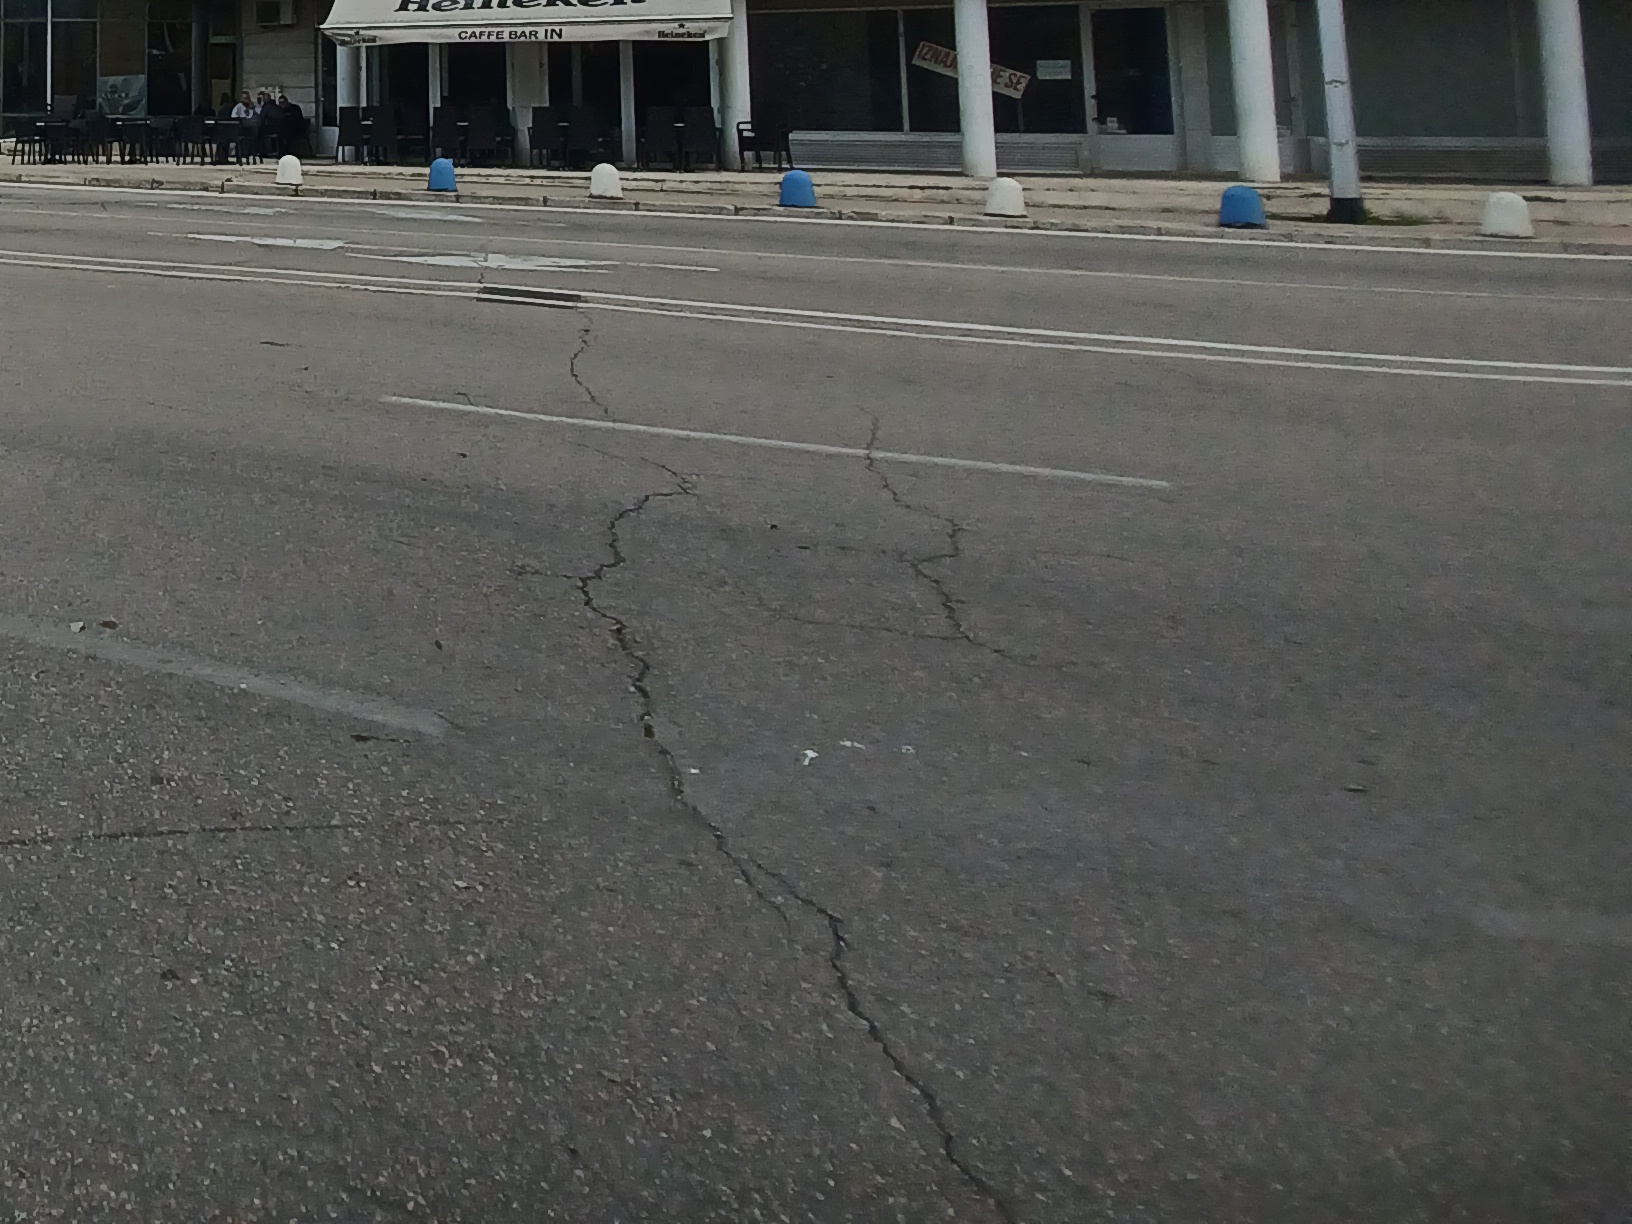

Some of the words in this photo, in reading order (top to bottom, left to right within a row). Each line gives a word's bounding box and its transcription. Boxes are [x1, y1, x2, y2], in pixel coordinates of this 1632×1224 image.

[457, 30, 505, 40] CAFFE
[509, 29, 539, 40] BAR
[544, 28, 563, 39] IN
[1004, 72, 1028, 92] SE
